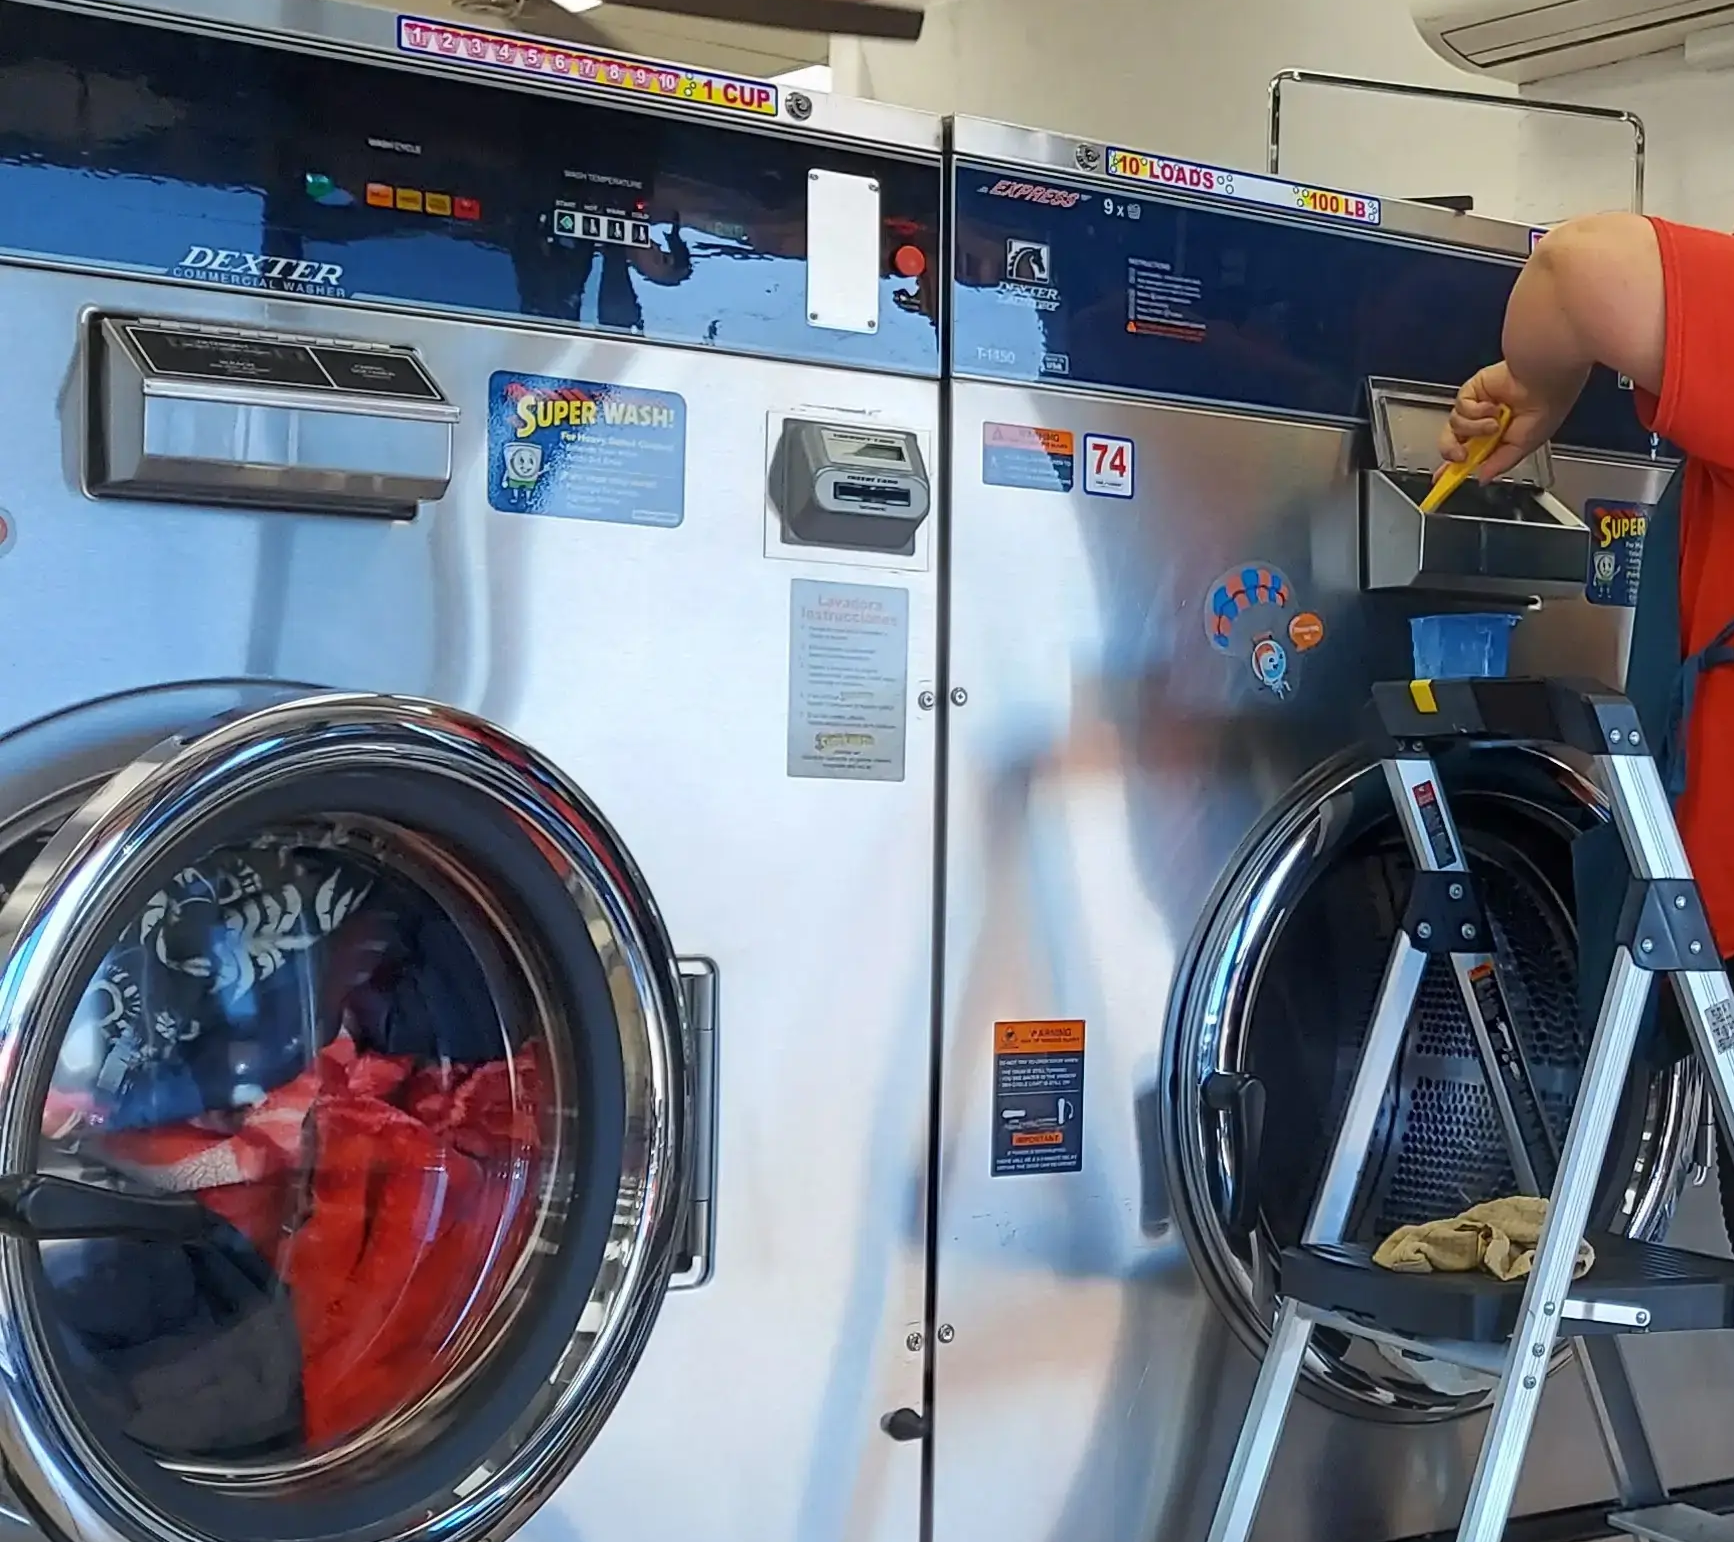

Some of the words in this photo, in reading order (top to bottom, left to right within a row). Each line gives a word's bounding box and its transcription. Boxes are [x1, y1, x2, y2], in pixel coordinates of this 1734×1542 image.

[702, 80, 713, 101] 1
[723, 82, 771, 109] CUP
[989, 179, 1080, 209] EXPRESS
[1119, 155, 1141, 176] 10
[1149, 160, 1215, 189] LOADS
[1310, 192, 1340, 213] 100
[1343, 198, 1366, 219] LB
[1103, 197, 1114, 215] 9
[178, 245, 344, 286] DEXTER
[172, 266, 277, 290] COMMERCIAL
[283, 281, 346, 299] WASHER
[999, 281, 1060, 301] DEXTER
[516, 394, 597, 438] SUPER
[603, 401, 676, 429] WASH!
[1091, 443, 1127, 478] 74
[1600, 515, 1647, 548] SUPER
